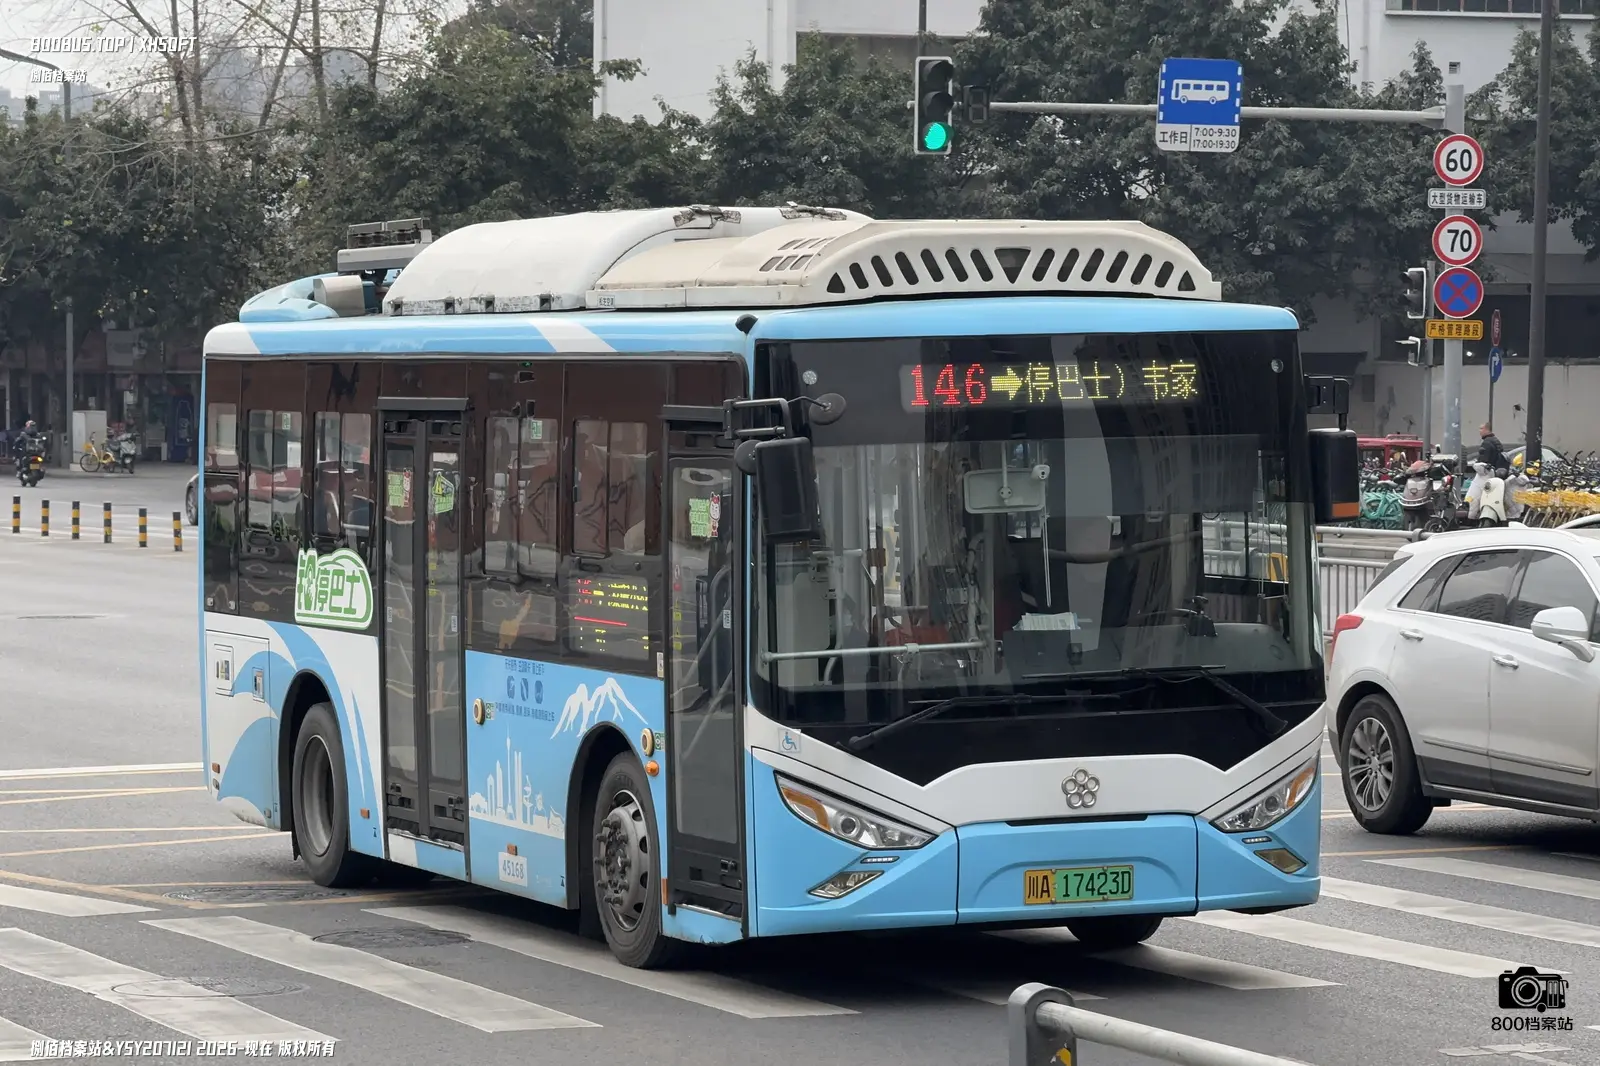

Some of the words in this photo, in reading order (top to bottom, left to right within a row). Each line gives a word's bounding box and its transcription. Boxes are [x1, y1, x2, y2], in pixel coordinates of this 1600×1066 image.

[1159, 130, 1188, 145] 工作日
[1194, 127, 1237, 138] 7:00-9:30
[1193, 139, 1236, 149] 17:00-19:30
[1445, 148, 1472, 172] 60
[1447, 229, 1472, 253] 70
[911, 363, 987, 406] 146
[502, 859, 525, 880] 45168
